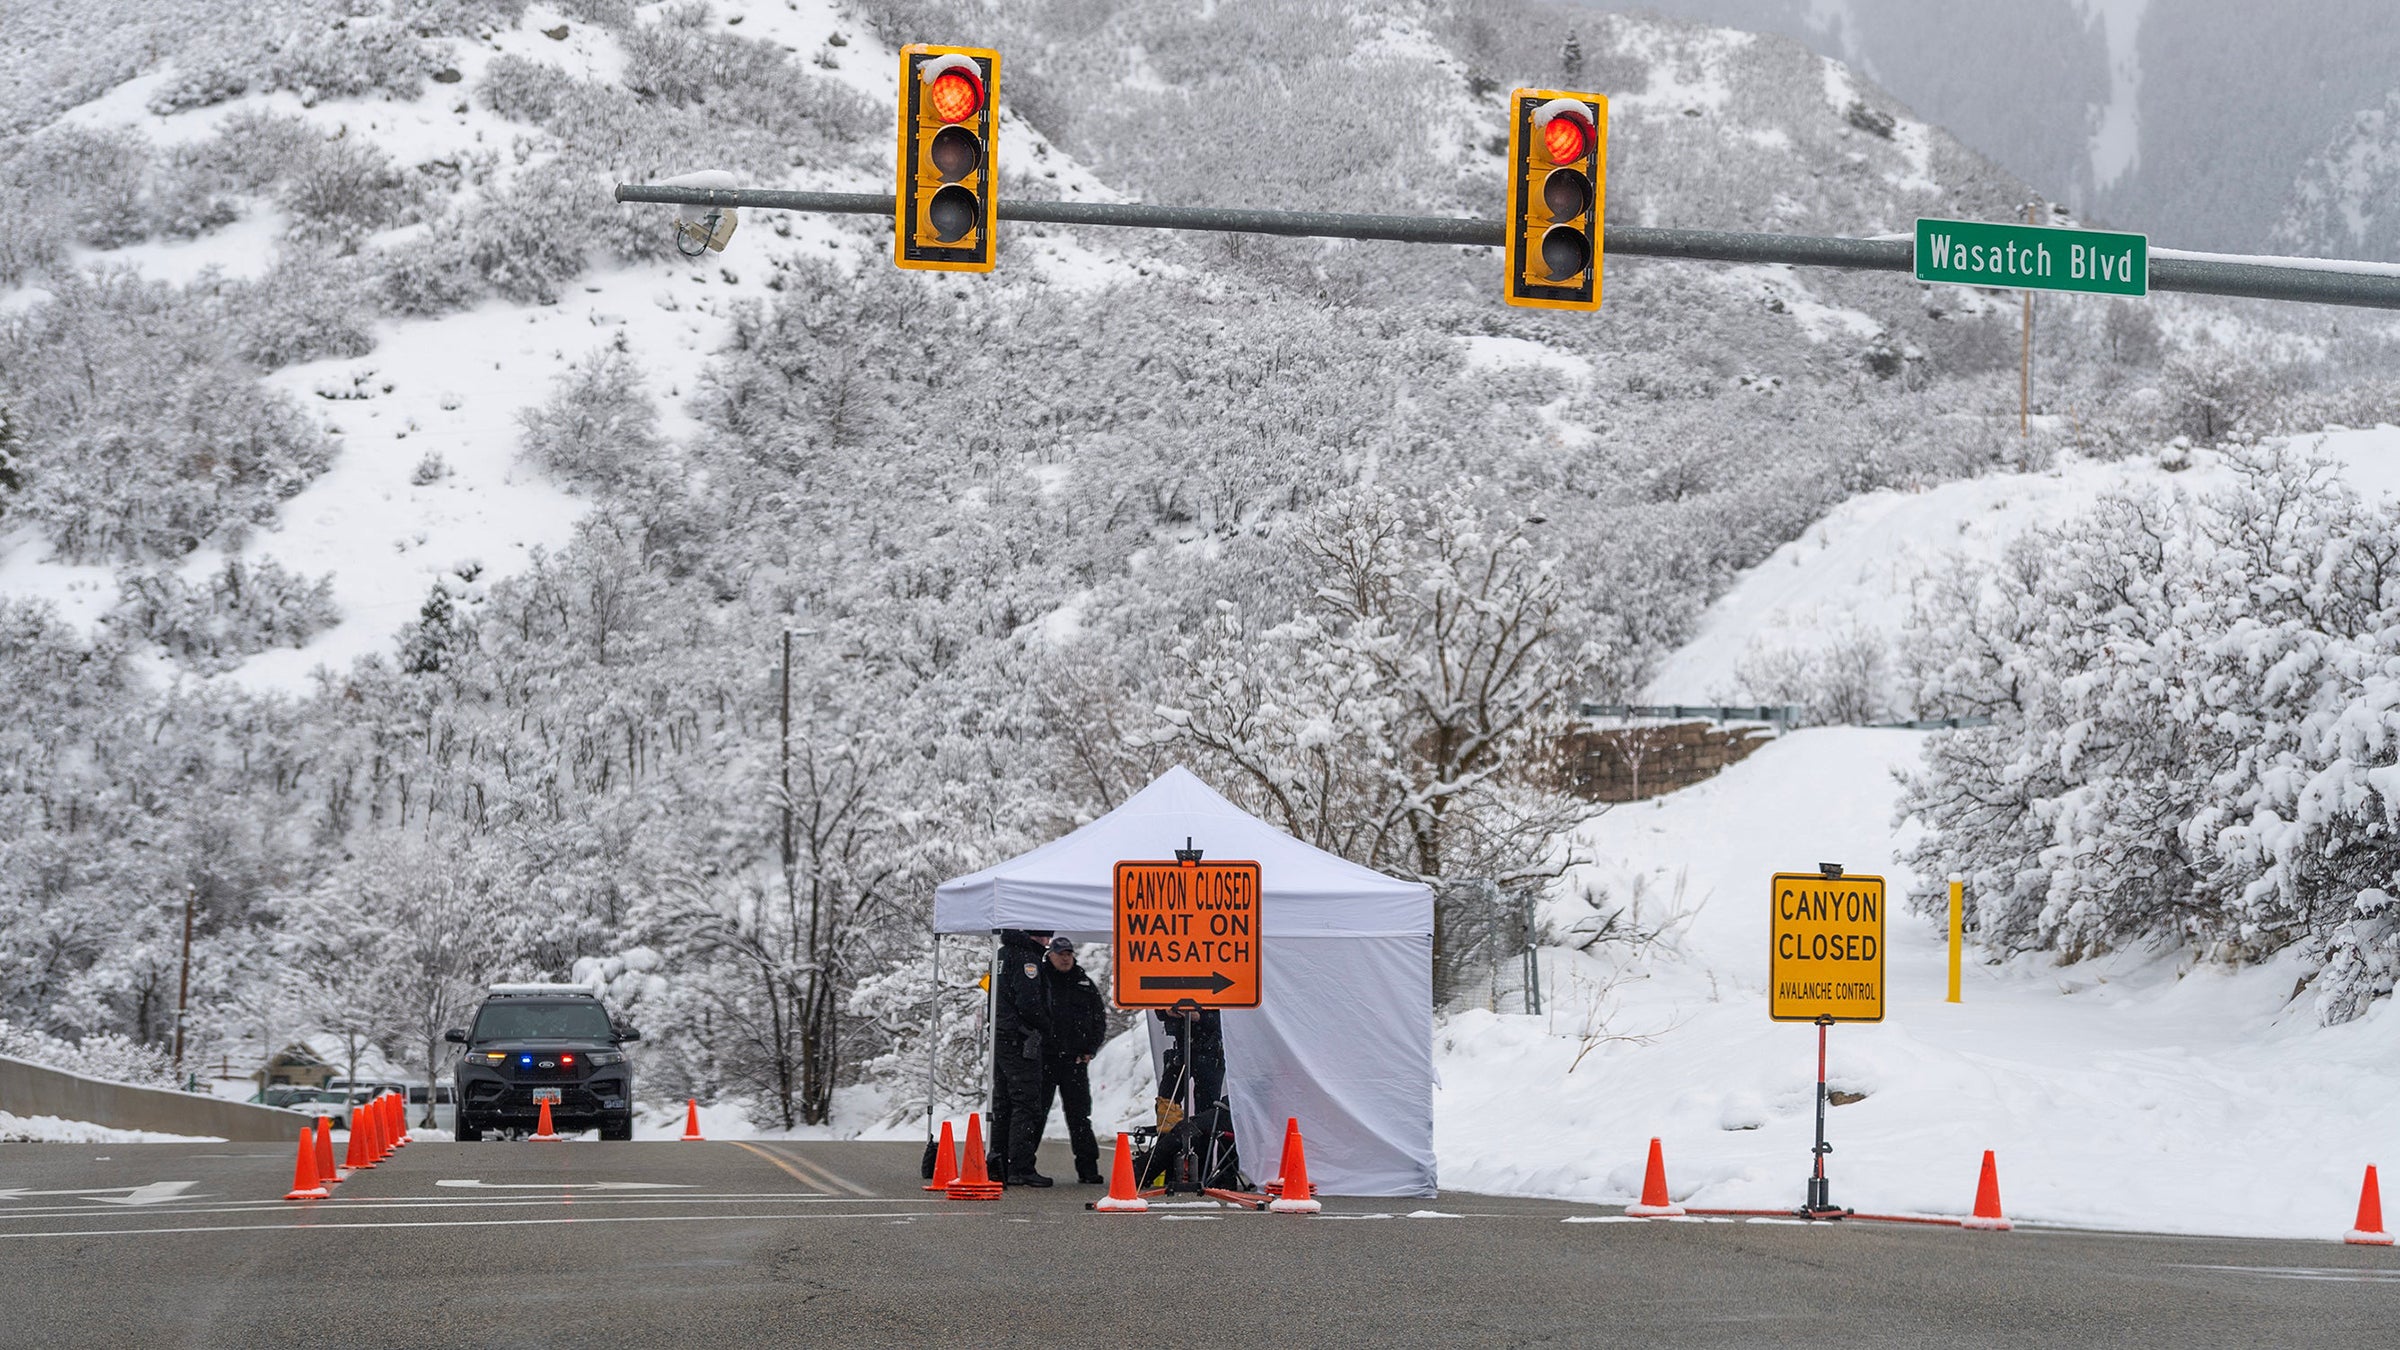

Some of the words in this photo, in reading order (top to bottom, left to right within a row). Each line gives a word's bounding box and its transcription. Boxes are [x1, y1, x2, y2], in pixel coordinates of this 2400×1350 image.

[1930, 233, 2051, 277] Wasatch
[2070, 244, 2132, 283] Blvd
[1126, 871, 1187, 910] CANYON
[1195, 871, 1251, 910] CLOSED
[1780, 890, 1877, 922] CANYON
[1127, 914, 1194, 936] WAIT
[1210, 914, 1249, 936] ON
[1128, 941, 1249, 963] WASATCH
[1779, 933, 1877, 961] CLOSED
[1779, 982, 1832, 1000] AVALANCHE
[1836, 983, 1876, 1000] CONTROL
